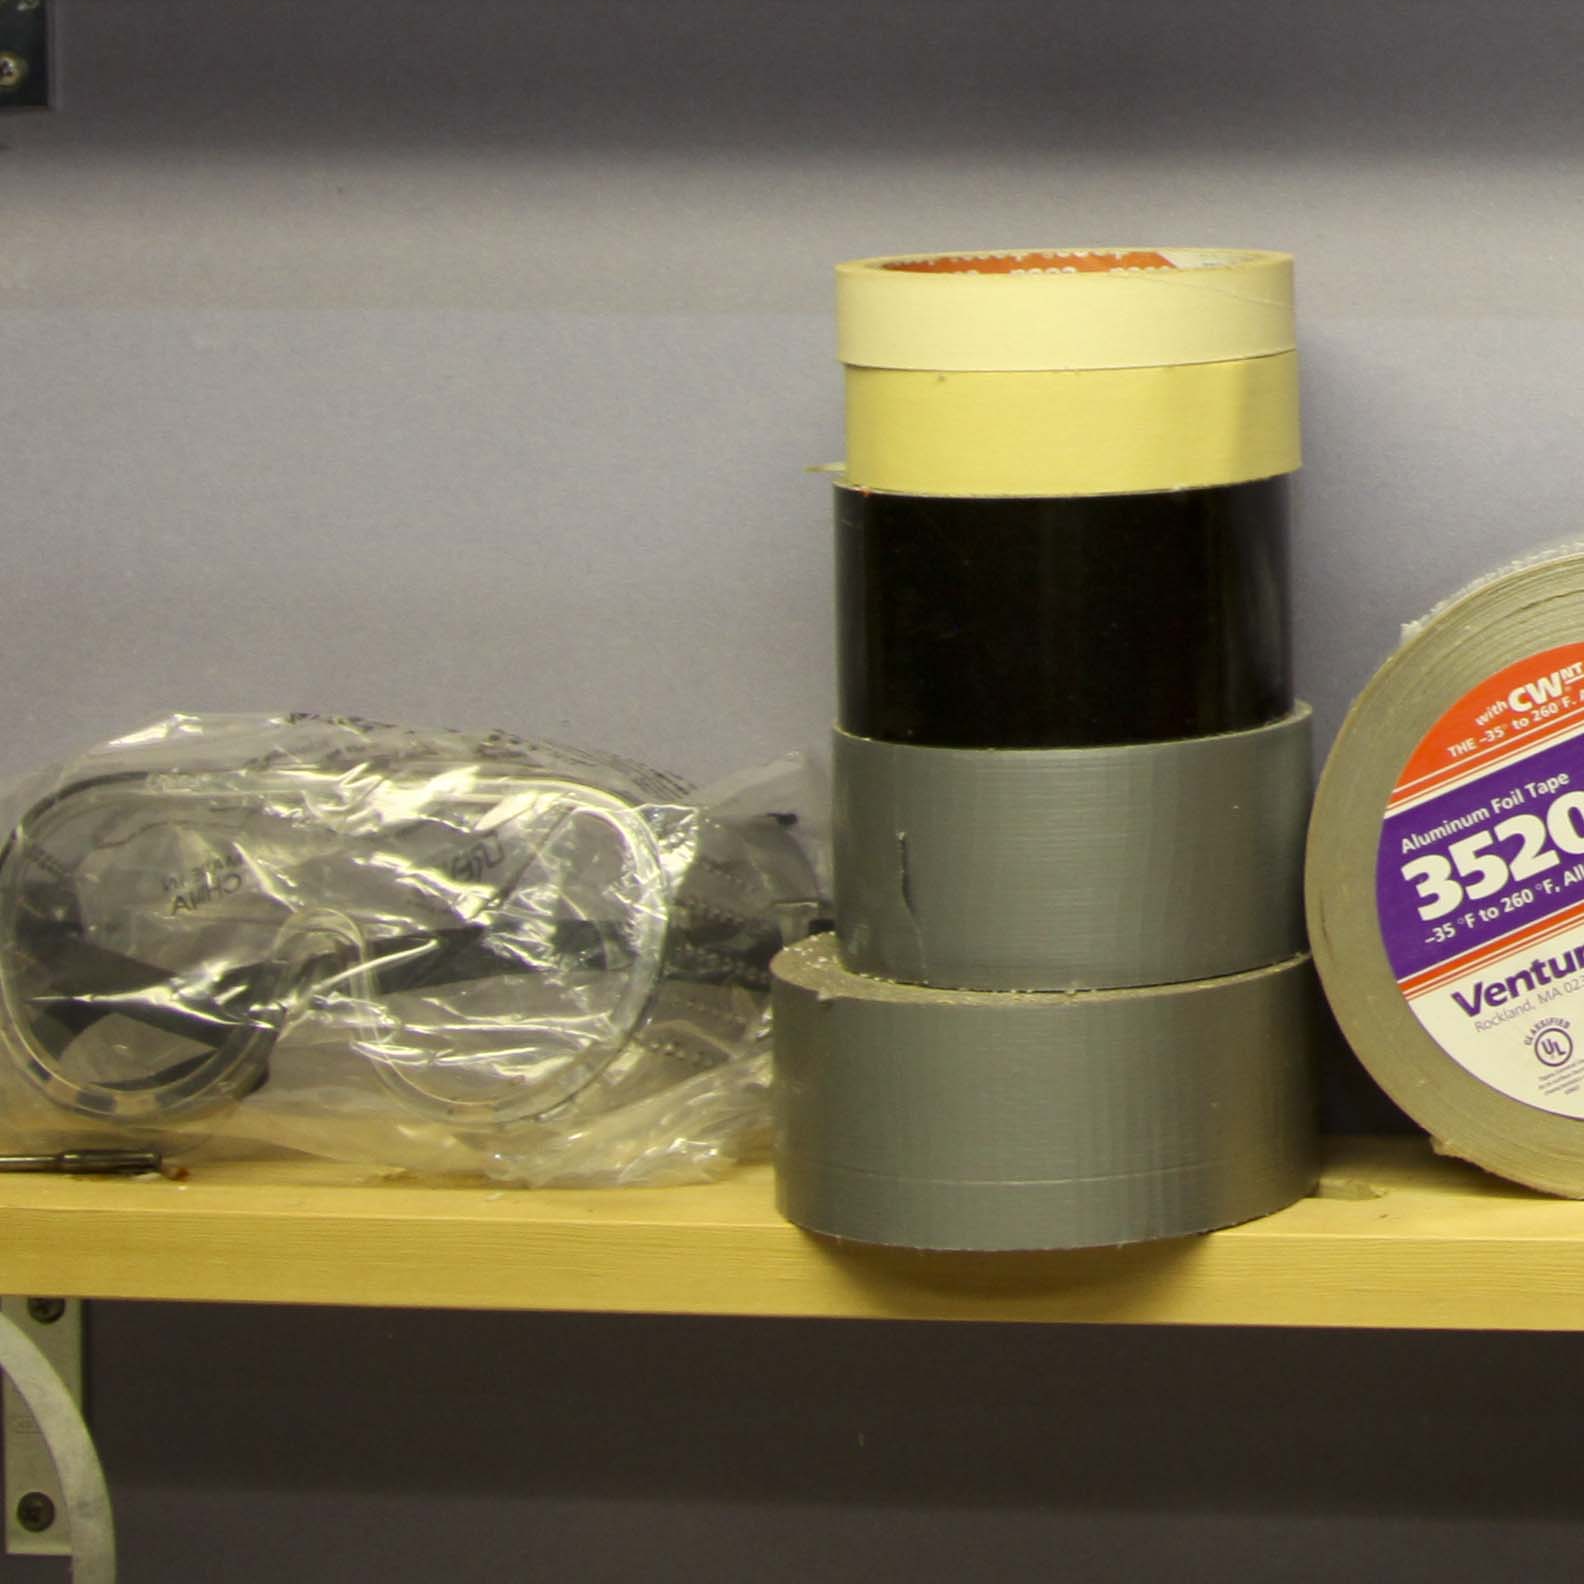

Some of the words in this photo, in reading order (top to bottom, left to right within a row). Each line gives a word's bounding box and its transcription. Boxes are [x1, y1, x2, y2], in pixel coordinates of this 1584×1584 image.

[1401, 805, 1491, 854] Aluminum
[1490, 787, 1525, 814] Foil
[1526, 771, 1570, 802] Tape
[1478, 904, 1500, 921] to
[1500, 888, 1534, 914] 260
[1474, 1002, 1537, 1033] Rockland,
[1538, 987, 1562, 1006] MA
